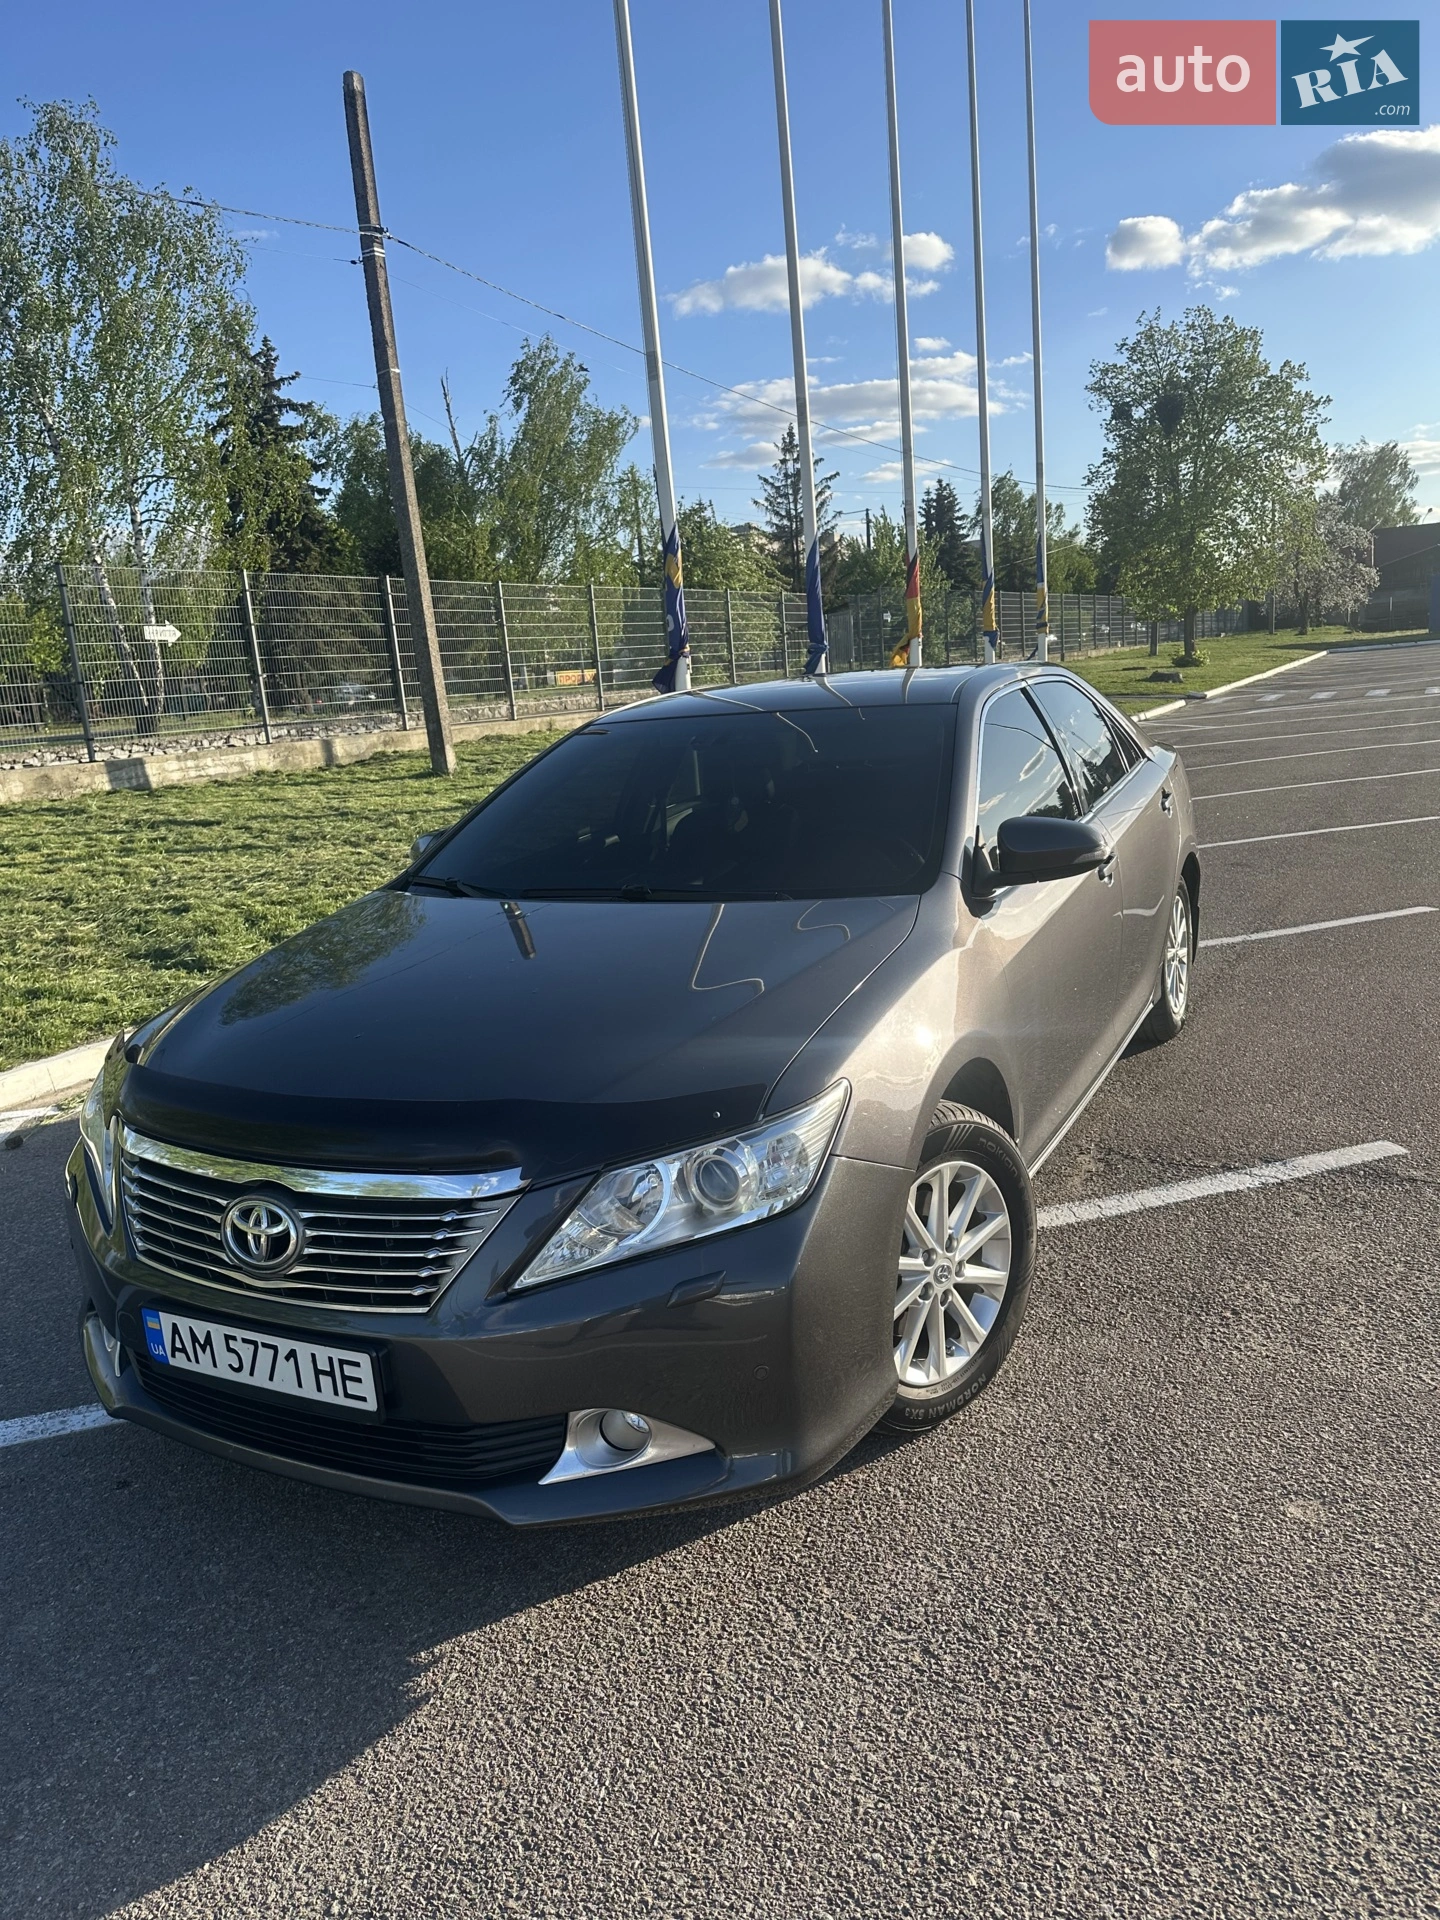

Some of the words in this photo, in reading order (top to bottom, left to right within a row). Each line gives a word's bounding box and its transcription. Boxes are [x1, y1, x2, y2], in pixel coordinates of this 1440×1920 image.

[150, 1342, 166, 1357] UA
[170, 1322, 218, 1369] AM
[223, 1333, 304, 1389] 5771
[311, 1352, 368, 1403] HE
[928, 1373, 987, 1419] NORDMAN
